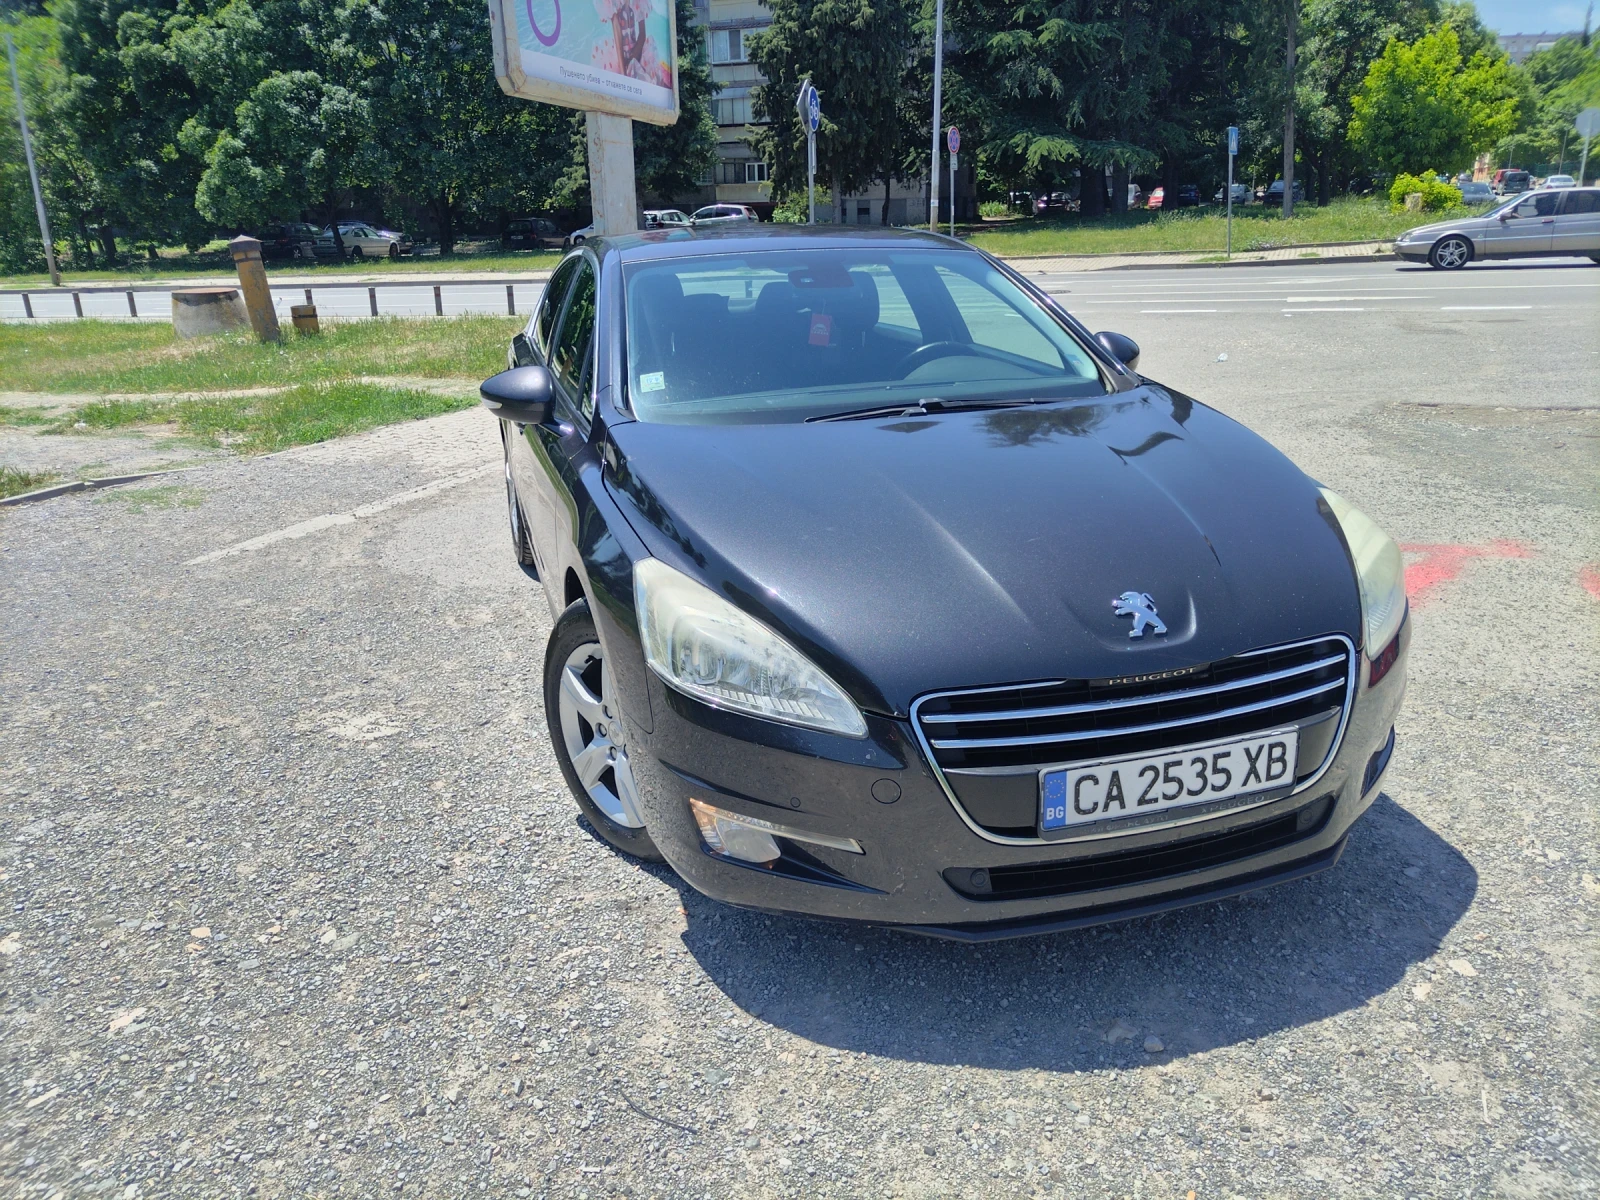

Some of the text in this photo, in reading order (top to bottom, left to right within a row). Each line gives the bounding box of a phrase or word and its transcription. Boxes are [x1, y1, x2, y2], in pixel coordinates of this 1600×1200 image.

[1108, 667, 1196, 685] PEUGEOT
[1073, 741, 1288, 816] CA 2535 XB
[1046, 805, 1065, 820] BG
